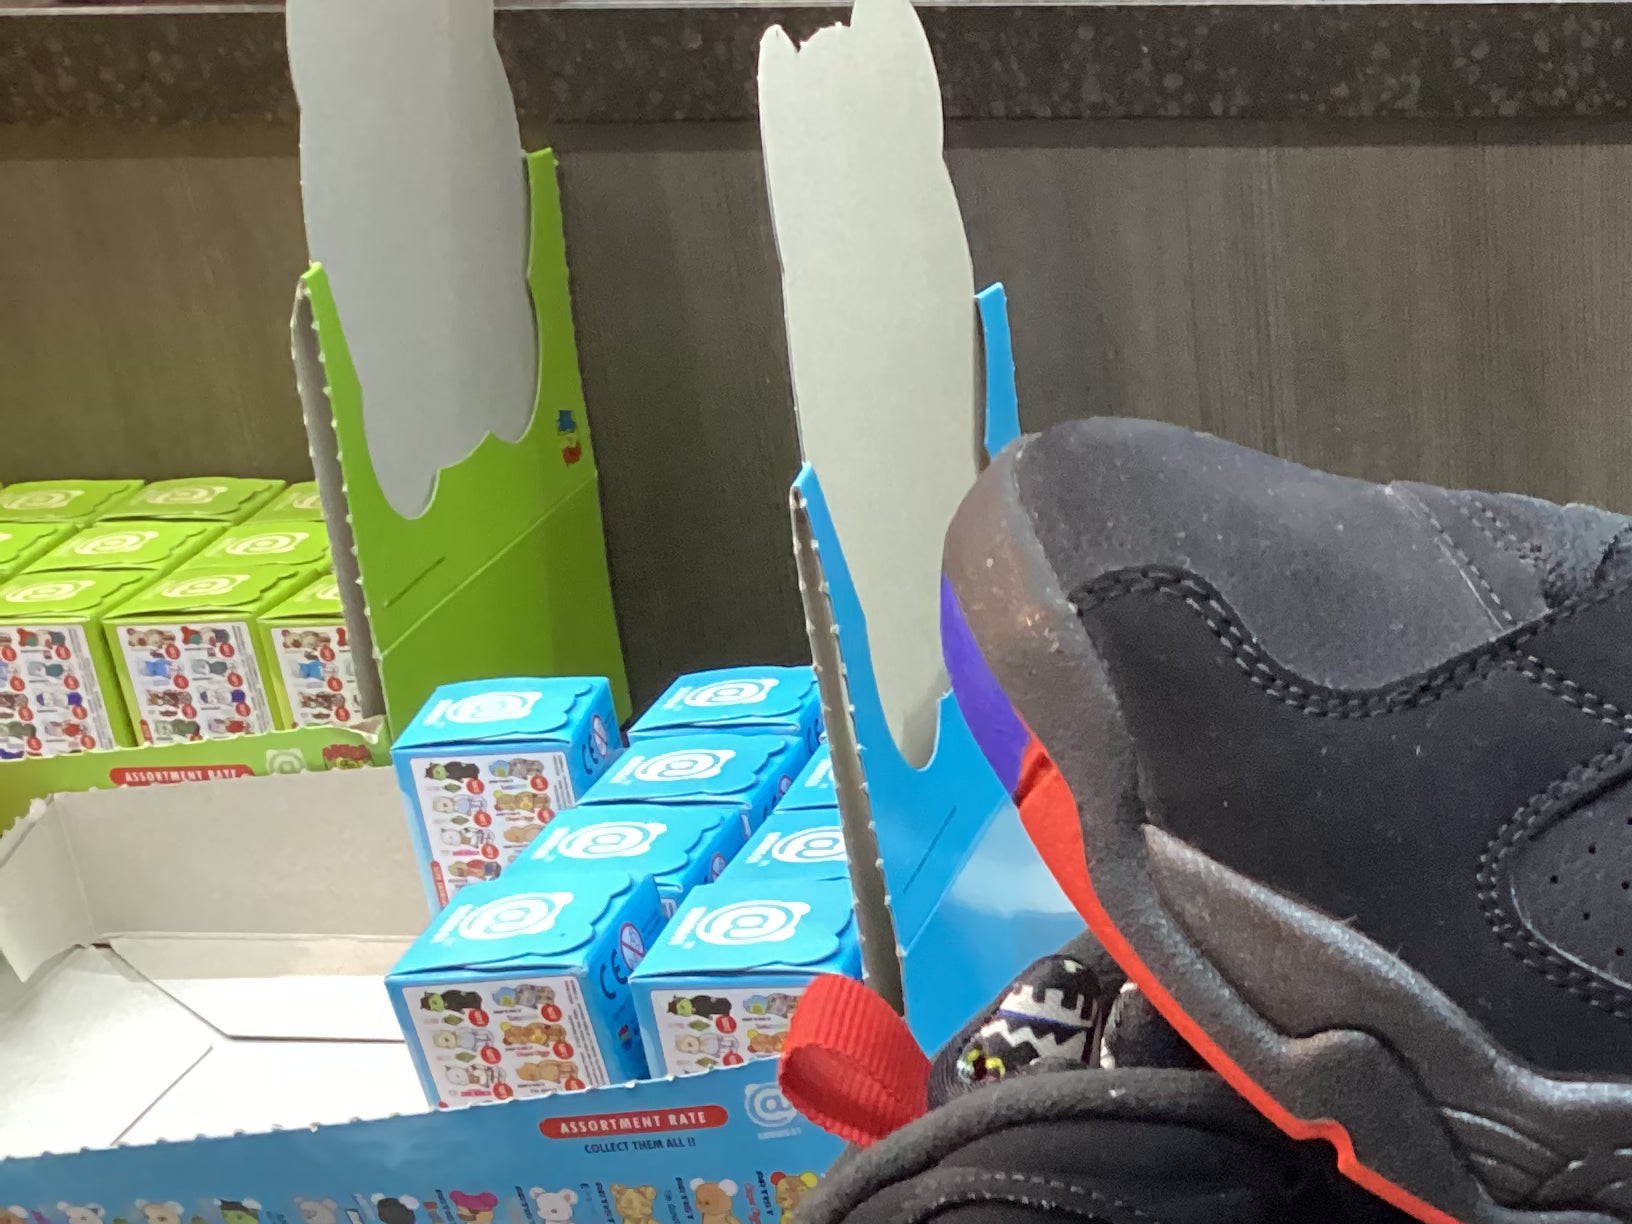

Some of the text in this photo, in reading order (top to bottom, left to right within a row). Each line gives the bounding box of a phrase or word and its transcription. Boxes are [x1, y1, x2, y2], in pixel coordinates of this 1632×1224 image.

[124, 770, 203, 783] ASSORTMENT
[559, 1111, 707, 1134] ASSORTMENT RATE
[584, 1141, 629, 1154] COLLECT
[633, 1139, 663, 1151] THEM
[666, 1137, 686, 1148] ALL
